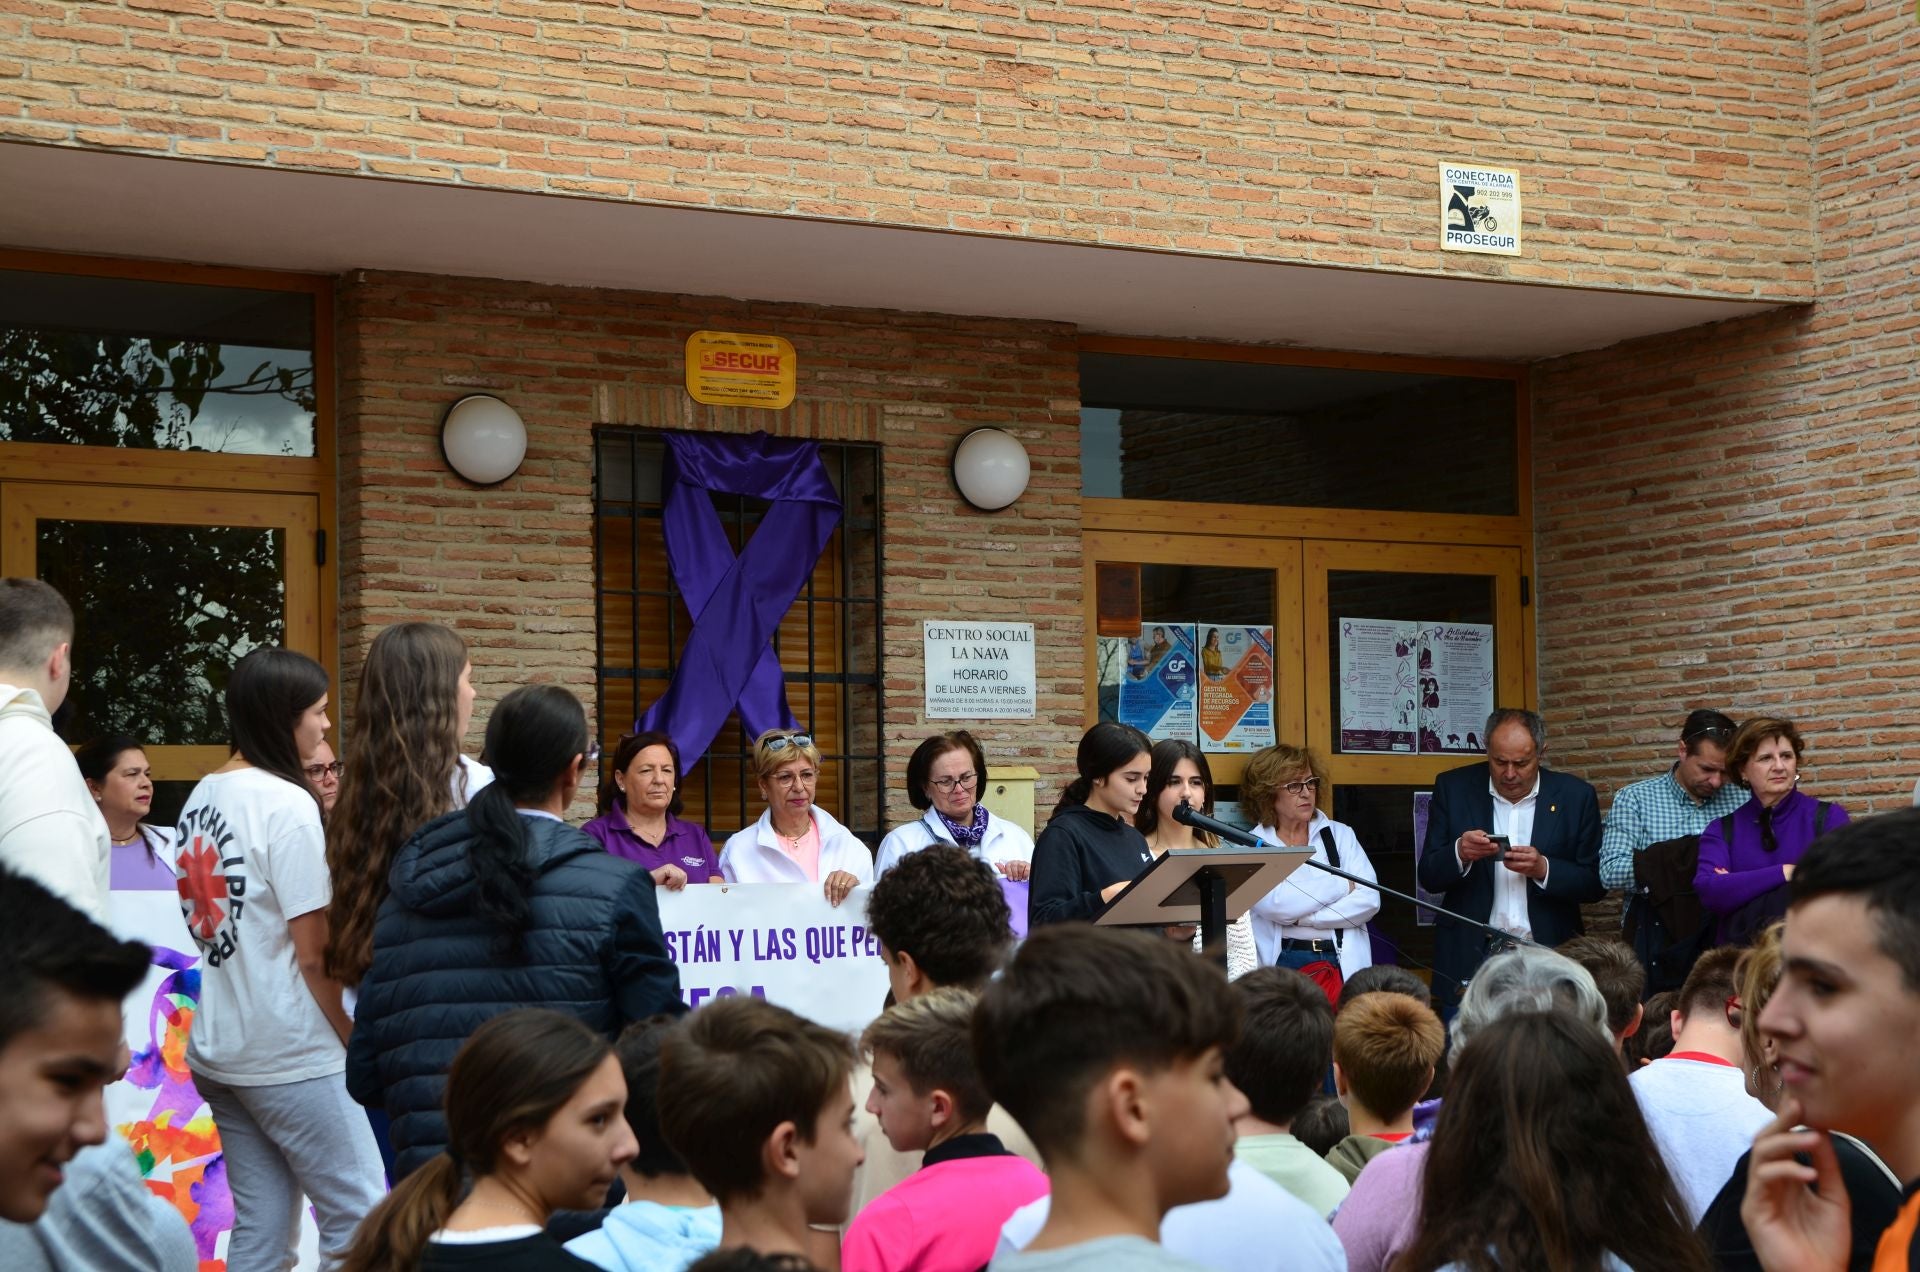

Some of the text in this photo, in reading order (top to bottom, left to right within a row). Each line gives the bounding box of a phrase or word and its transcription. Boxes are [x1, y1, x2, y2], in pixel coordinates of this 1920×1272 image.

[1446, 169, 1513, 184] CONECTADA
[1446, 232, 1515, 248] PROSEGUR
[714, 351, 781, 371] SECUR
[928, 628, 1032, 642] CENTRO SOCIAL
[951, 646, 1009, 660] LA NAVA
[953, 668, 1008, 681] HORARIO
[935, 685, 1027, 695] DE LUNES A VIERNES
[663, 924, 882, 965] STÁN Y LAS QUE PE
